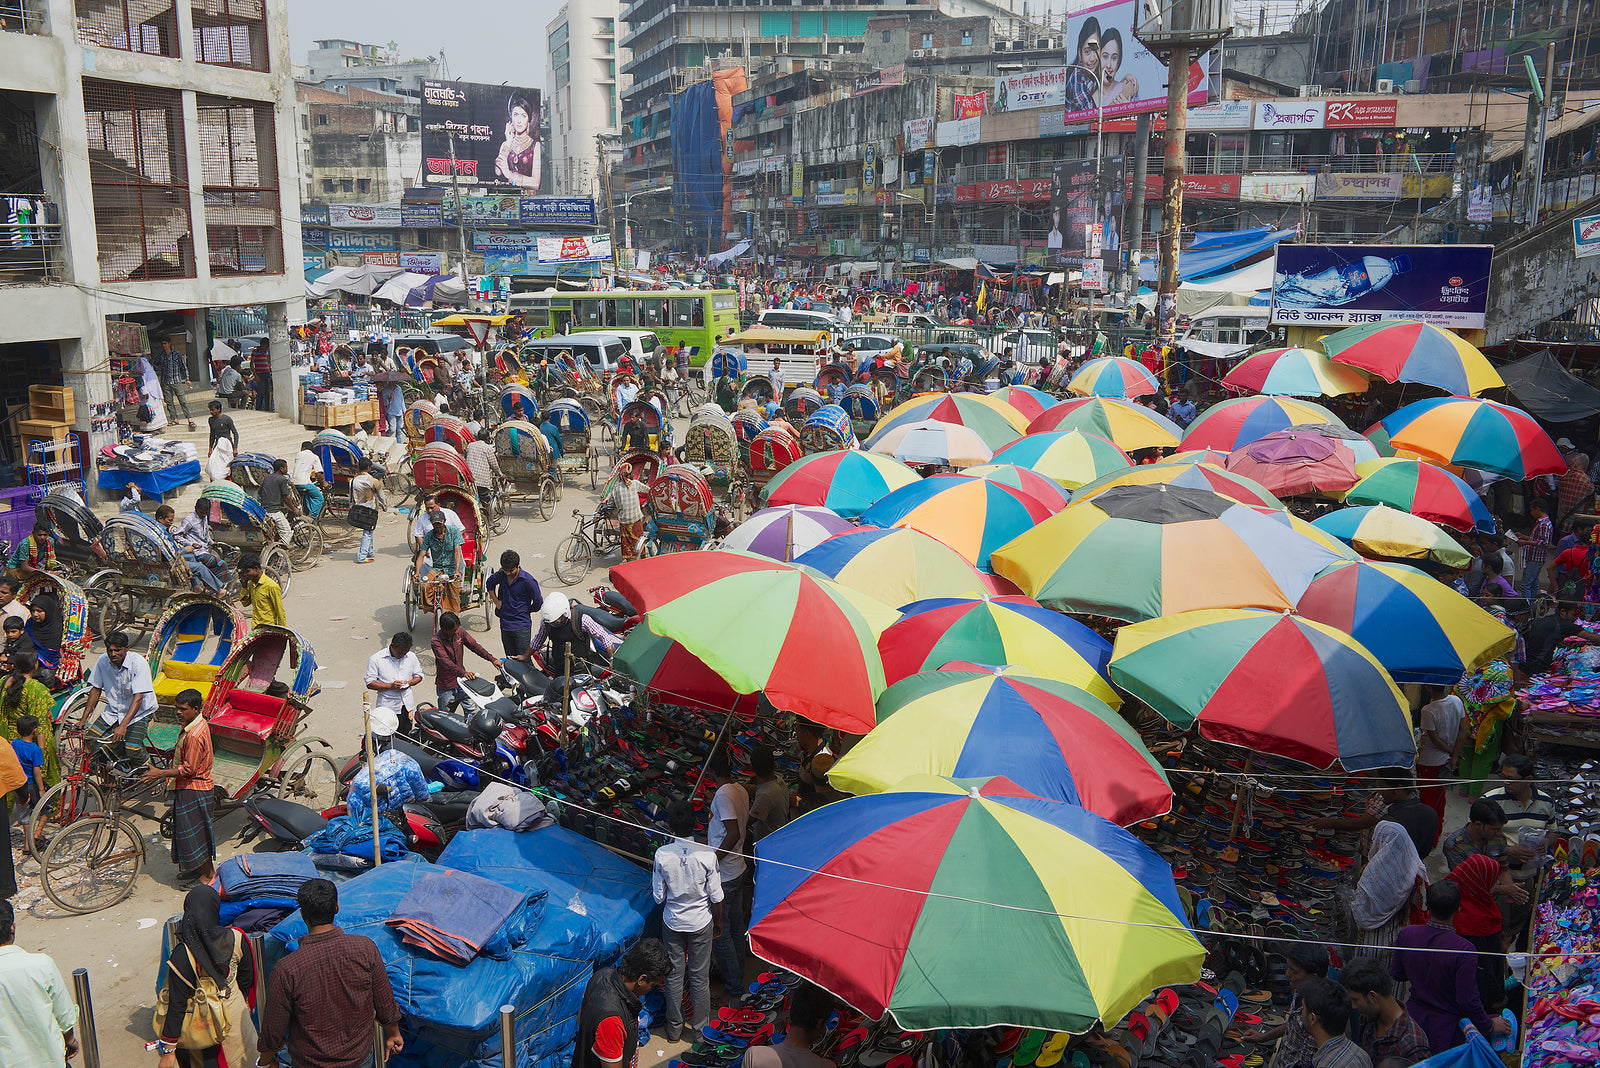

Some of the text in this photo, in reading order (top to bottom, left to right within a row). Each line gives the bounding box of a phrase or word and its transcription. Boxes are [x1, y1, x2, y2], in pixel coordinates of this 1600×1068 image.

[1017, 91, 1047, 102] JOTEY
[1223, 103, 1249, 112] Fashion
[1328, 102, 1357, 121] RK
[1272, 109, 1319, 126] প্রজাপতি
[426, 158, 478, 176] আপন
[1440, 295, 1469, 304] ওয়াটার
[1277, 308, 1301, 321] নিউ
[1304, 311, 1345, 322] আনন্দ
